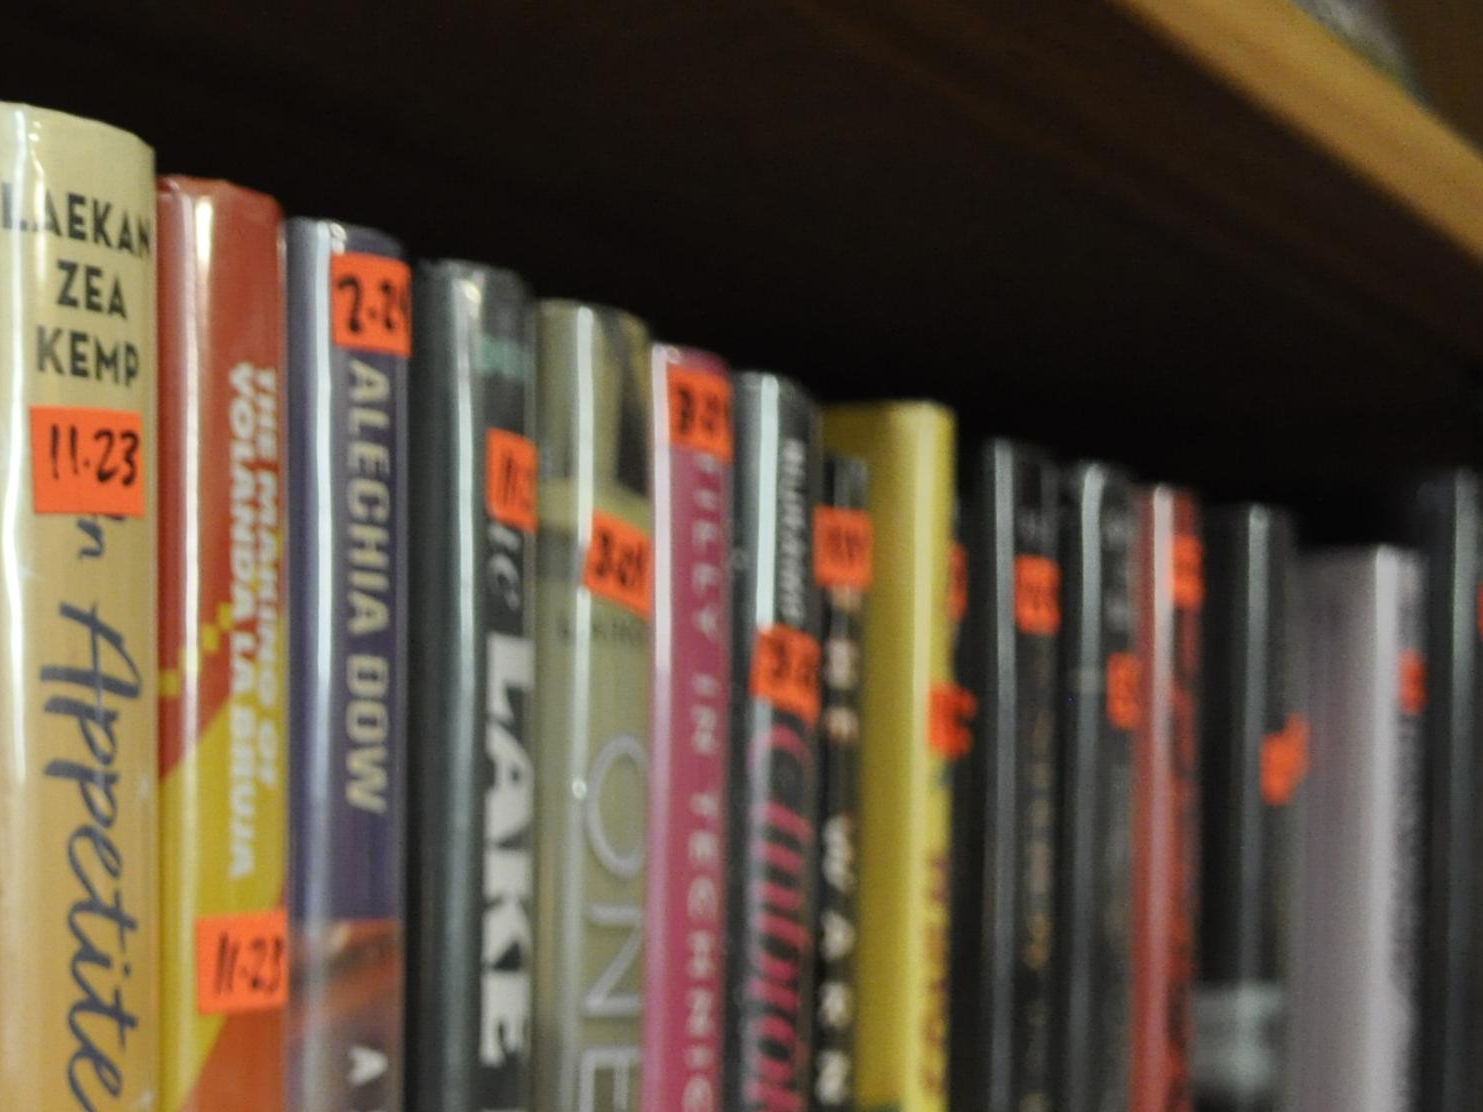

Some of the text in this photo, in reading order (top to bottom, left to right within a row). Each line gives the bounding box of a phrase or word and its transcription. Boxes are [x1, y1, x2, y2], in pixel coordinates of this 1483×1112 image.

[0, 180, 155, 261] LAEKAN
[55, 257, 127, 320] ZEA
[34, 324, 141, 391] KEMP
[49, 424, 143, 487] 11.23
[229, 362, 257, 881] YOLANDA LA BRUJA
[343, 358, 390, 815] ALECHIA DOW
[479, 630, 536, 1069] LAKE
[347, 1046, 390, 1086] A
